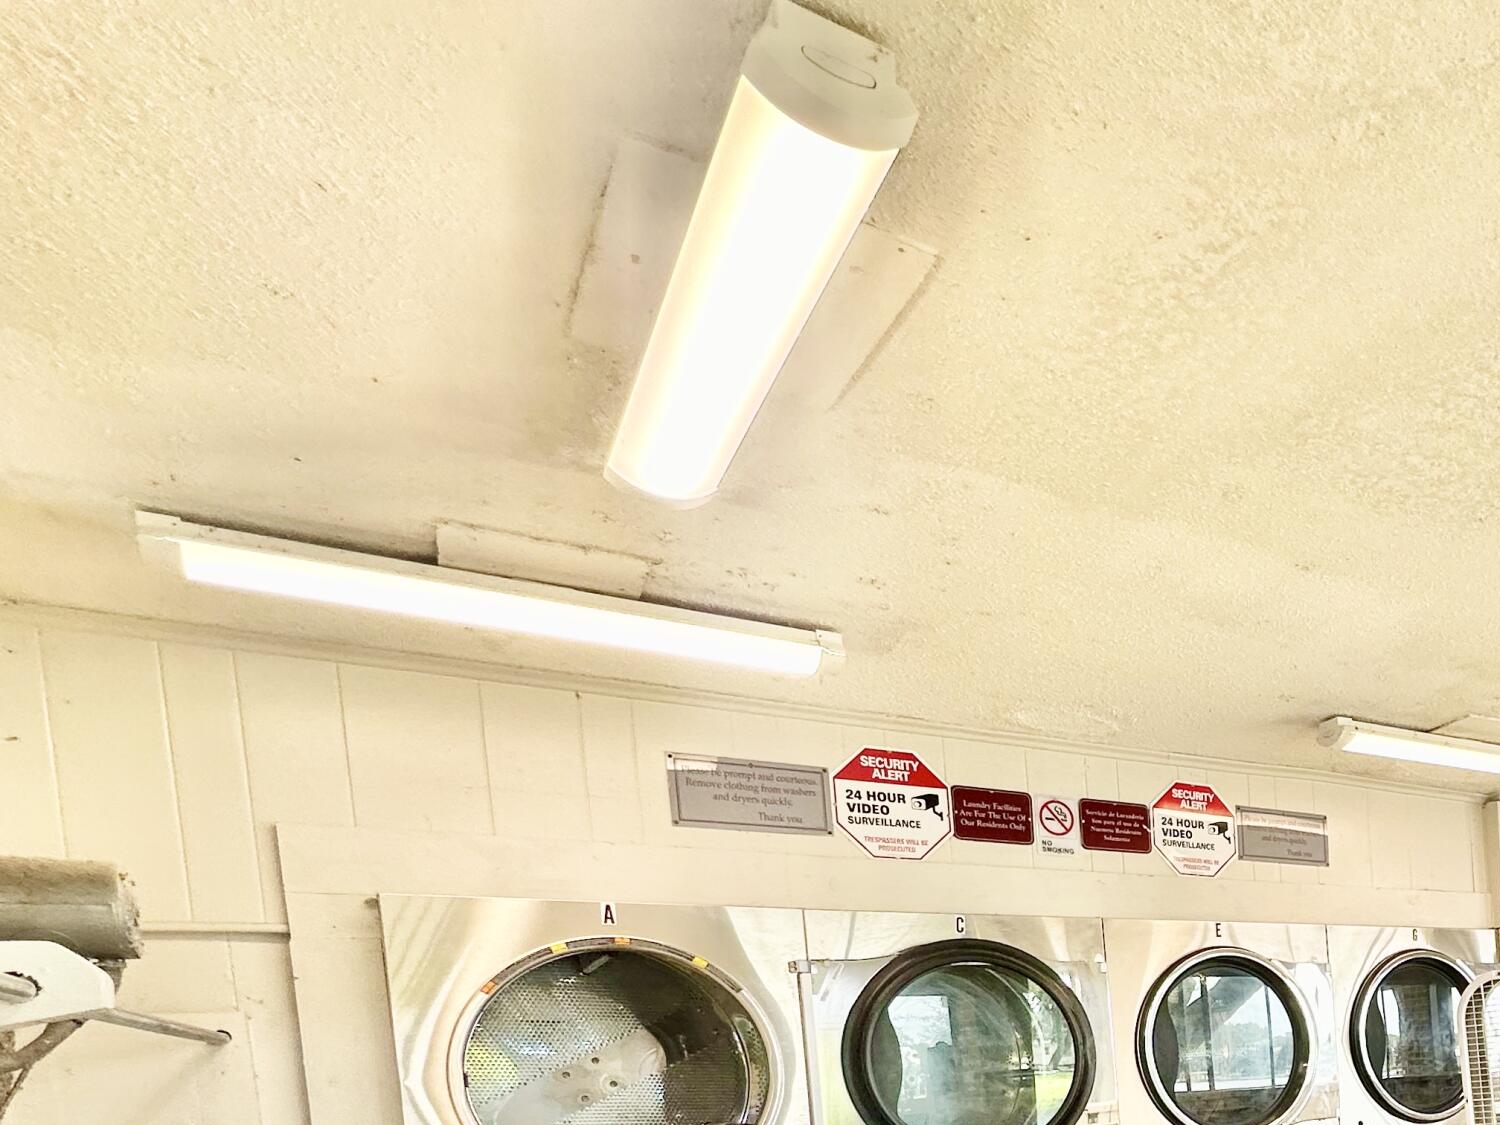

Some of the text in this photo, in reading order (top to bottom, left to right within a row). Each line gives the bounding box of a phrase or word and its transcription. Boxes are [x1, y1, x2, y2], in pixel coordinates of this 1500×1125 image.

[859, 755, 920, 772] SECURITY
[723, 770, 757, 783] prompt
[758, 772, 775, 781] and
[871, 768, 911, 782] ALERT
[685, 776, 817, 797] Remove clothing from washers
[712, 792, 730, 802] and
[731, 793, 760, 805] dryers
[845, 789, 907, 804] 24 HOUR
[1171, 788, 1215, 803] SECURITY
[846, 802, 890, 816] VIDEO
[962, 799, 991, 810] Laundry
[1179, 799, 1208, 811] ALERT
[758, 811, 785, 822] Thank
[847, 815, 921, 829] SURVEILLANCE
[959, 809, 1026, 822] Are For The Use Of
[960, 819, 1026, 832] Our Residents Only
[1161, 816, 1205, 830] 24 HOUR
[1161, 827, 1193, 839] VIDEO
[1042, 846, 1075, 855] SMOKING
[1162, 838, 1215, 851] SURVEILLANCE
[604, 904, 615, 924] A
[957, 916, 965, 933] C
[1216, 922, 1222, 938] E
[1413, 928, 1418, 941] G
